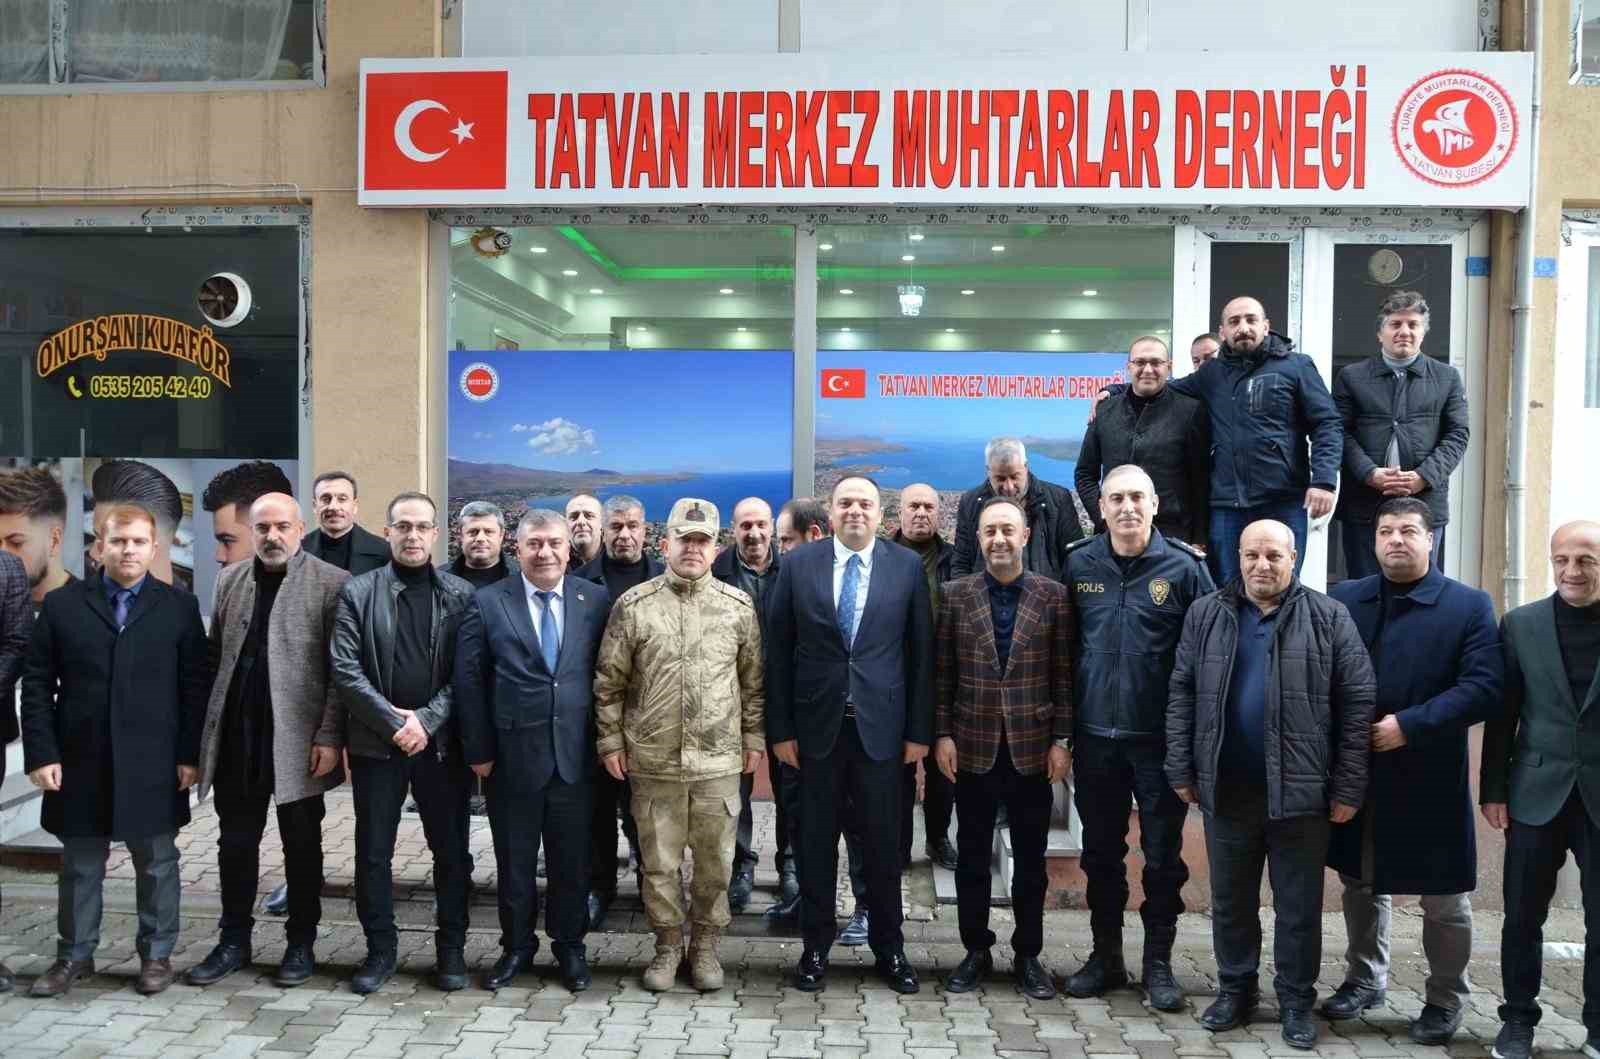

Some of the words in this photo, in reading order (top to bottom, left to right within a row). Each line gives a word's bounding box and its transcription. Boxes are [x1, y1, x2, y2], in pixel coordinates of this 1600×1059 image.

[1423, 78, 1487, 93] MUHTARLAR
[528, 92, 689, 189] TATVAN
[703, 90, 881, 189] MERKEZ
[893, 88, 1160, 189] MUHTARLAR
[1175, 65, 1367, 190] DERNEĞİ
[1413, 155, 1453, 178] TATVAN
[37, 315, 139, 377] ONURŞAN
[141, 315, 231, 388] KUAFÖR
[91, 376, 131, 397] 0535
[132, 376, 164, 397] 205
[165, 376, 187, 398] 42
[189, 376, 211, 398] 40
[879, 374, 927, 397] TATVAN
[931, 374, 984, 398] MERKEZ
[987, 375, 1066, 398] MUHTARLAR
